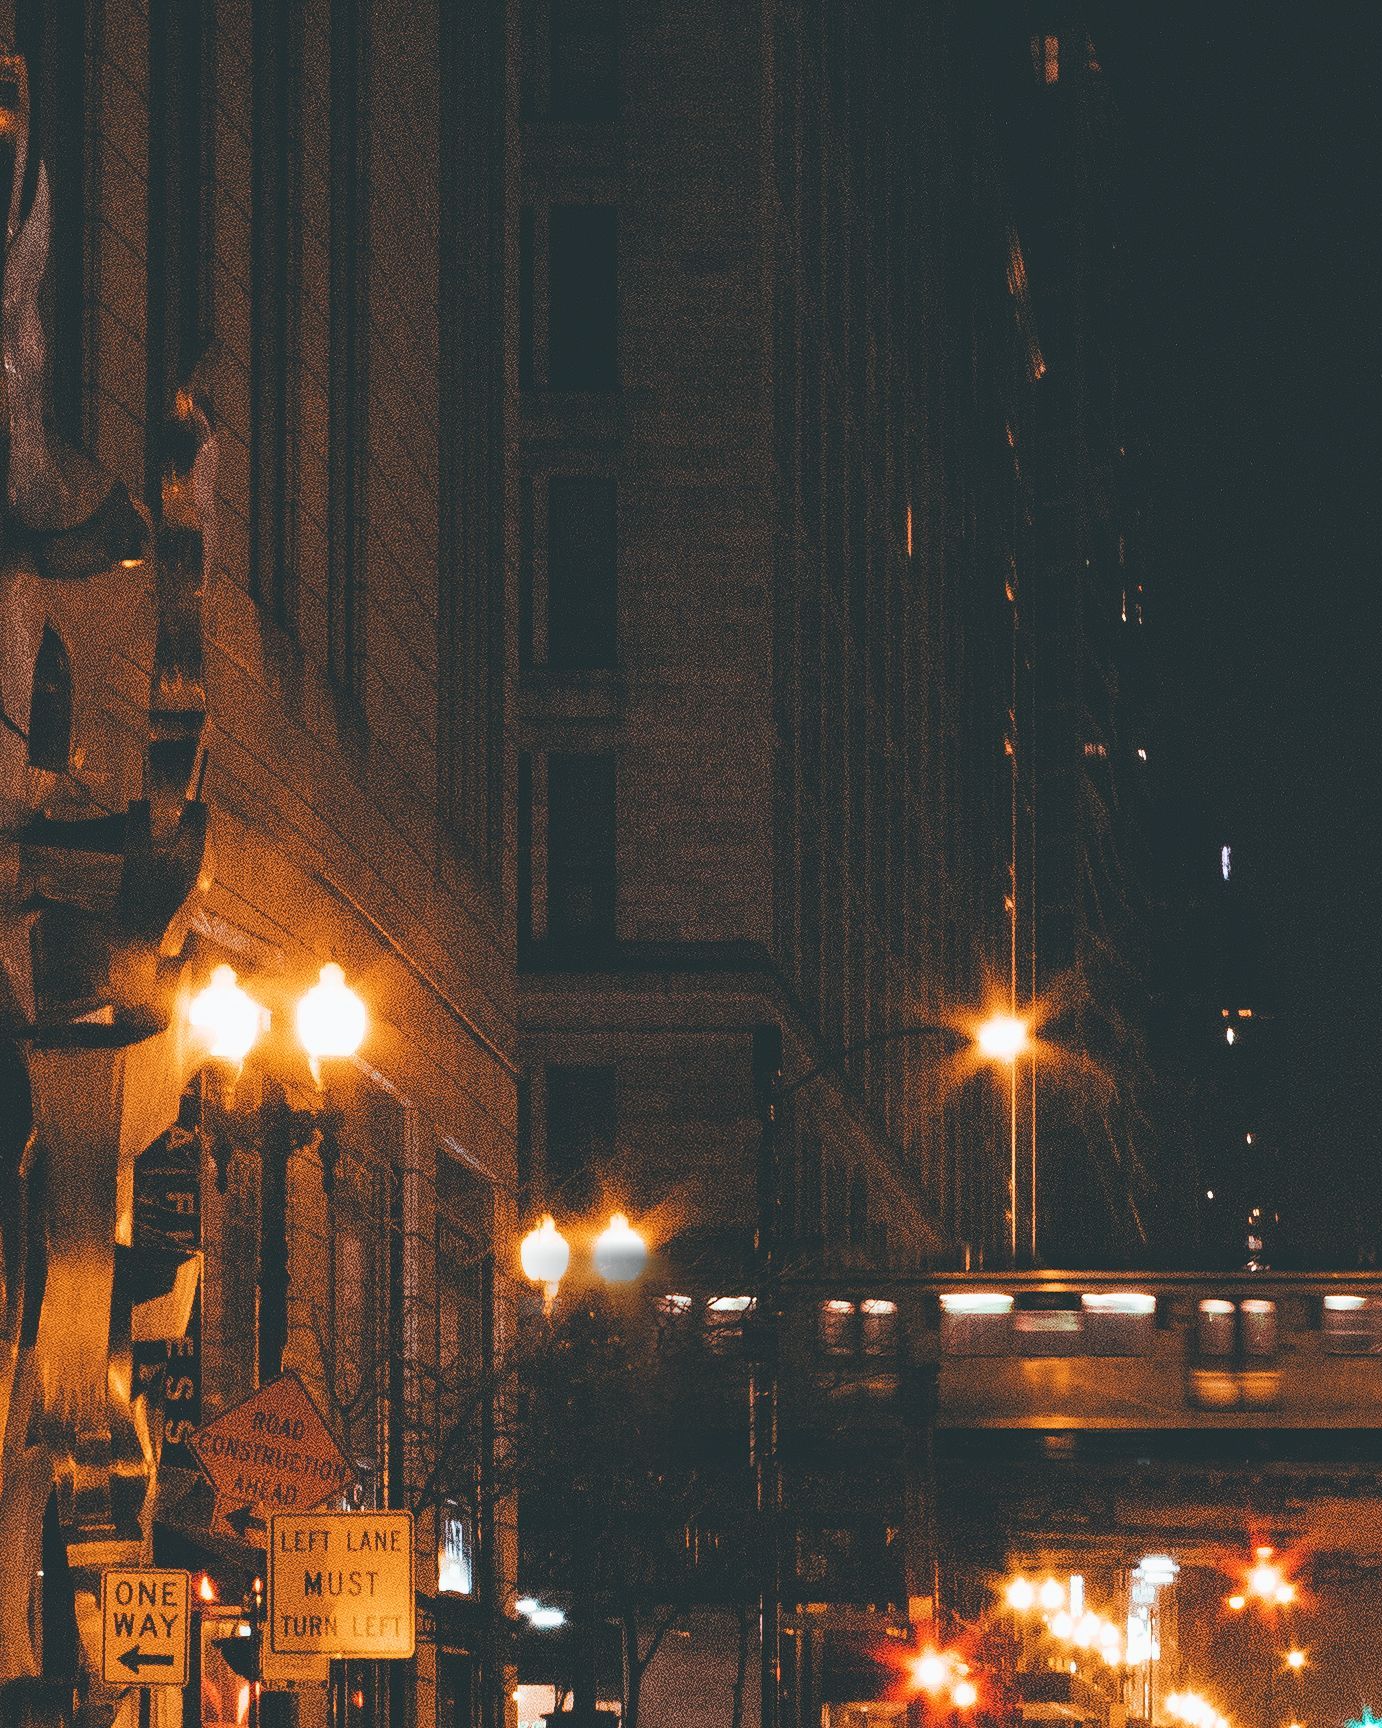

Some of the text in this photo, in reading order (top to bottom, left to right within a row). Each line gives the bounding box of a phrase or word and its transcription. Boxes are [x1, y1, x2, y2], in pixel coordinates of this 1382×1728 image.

[252, 1412, 305, 1441] ROAD
[199, 1433, 346, 1482] CONSTRUCTION
[233, 1475, 299, 1505] AHEAD
[281, 1531, 401, 1552] LEFT LANE
[115, 1581, 178, 1607] ONE
[305, 1571, 378, 1597] MUST
[113, 1613, 179, 1639] WAY
[281, 1616, 401, 1638] TURN LEFT
